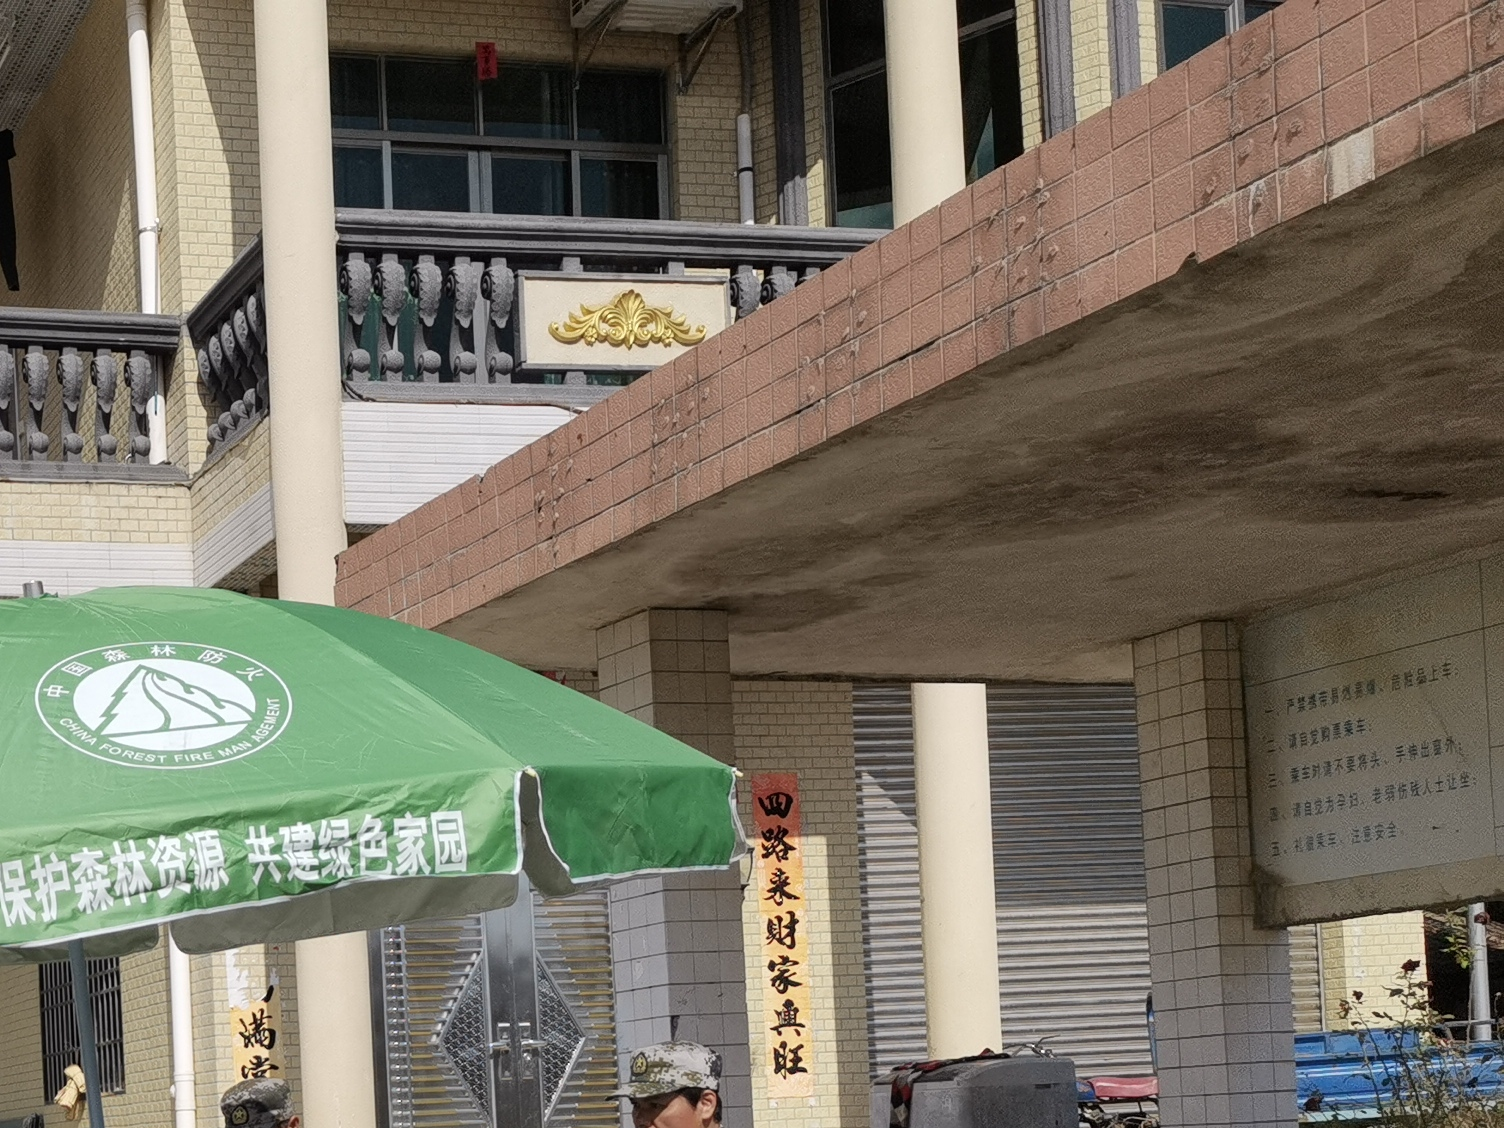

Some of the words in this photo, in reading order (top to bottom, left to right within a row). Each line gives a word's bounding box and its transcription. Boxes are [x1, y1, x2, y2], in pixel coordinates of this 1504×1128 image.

[43, 644, 264, 698] 中国森林防火
[60, 717, 98, 746] CHINA
[99, 742, 167, 764] FOREST
[174, 751, 215, 763] FIRE
[245, 809, 469, 886] 共建绿色家园
